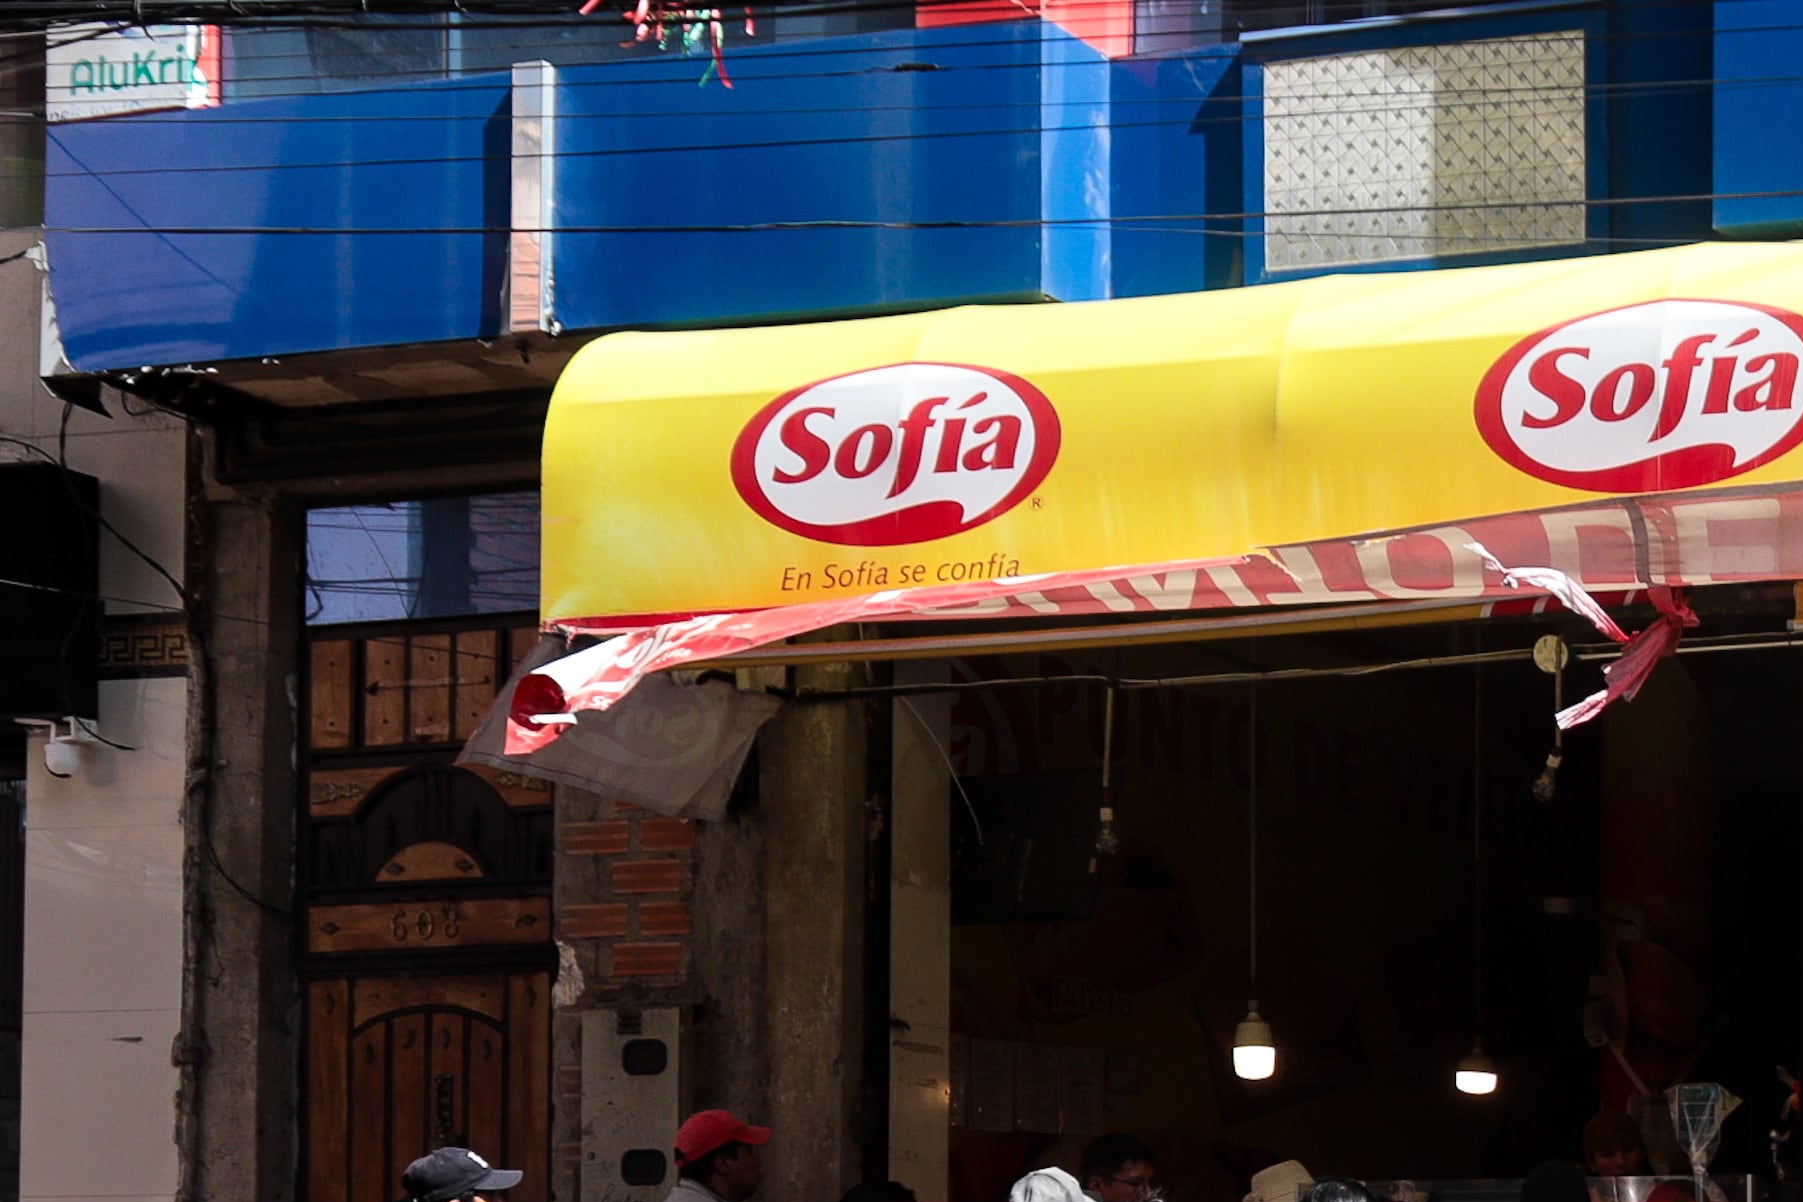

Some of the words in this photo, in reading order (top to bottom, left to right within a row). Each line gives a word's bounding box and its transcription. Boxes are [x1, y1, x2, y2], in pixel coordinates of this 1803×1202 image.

[1521, 327, 1800, 443] Sofía
[772, 391, 1022, 500] Sofía
[781, 567, 812, 591] En
[822, 560, 889, 589] Sofía
[898, 564, 926, 584] se
[936, 552, 1020, 581] confía
